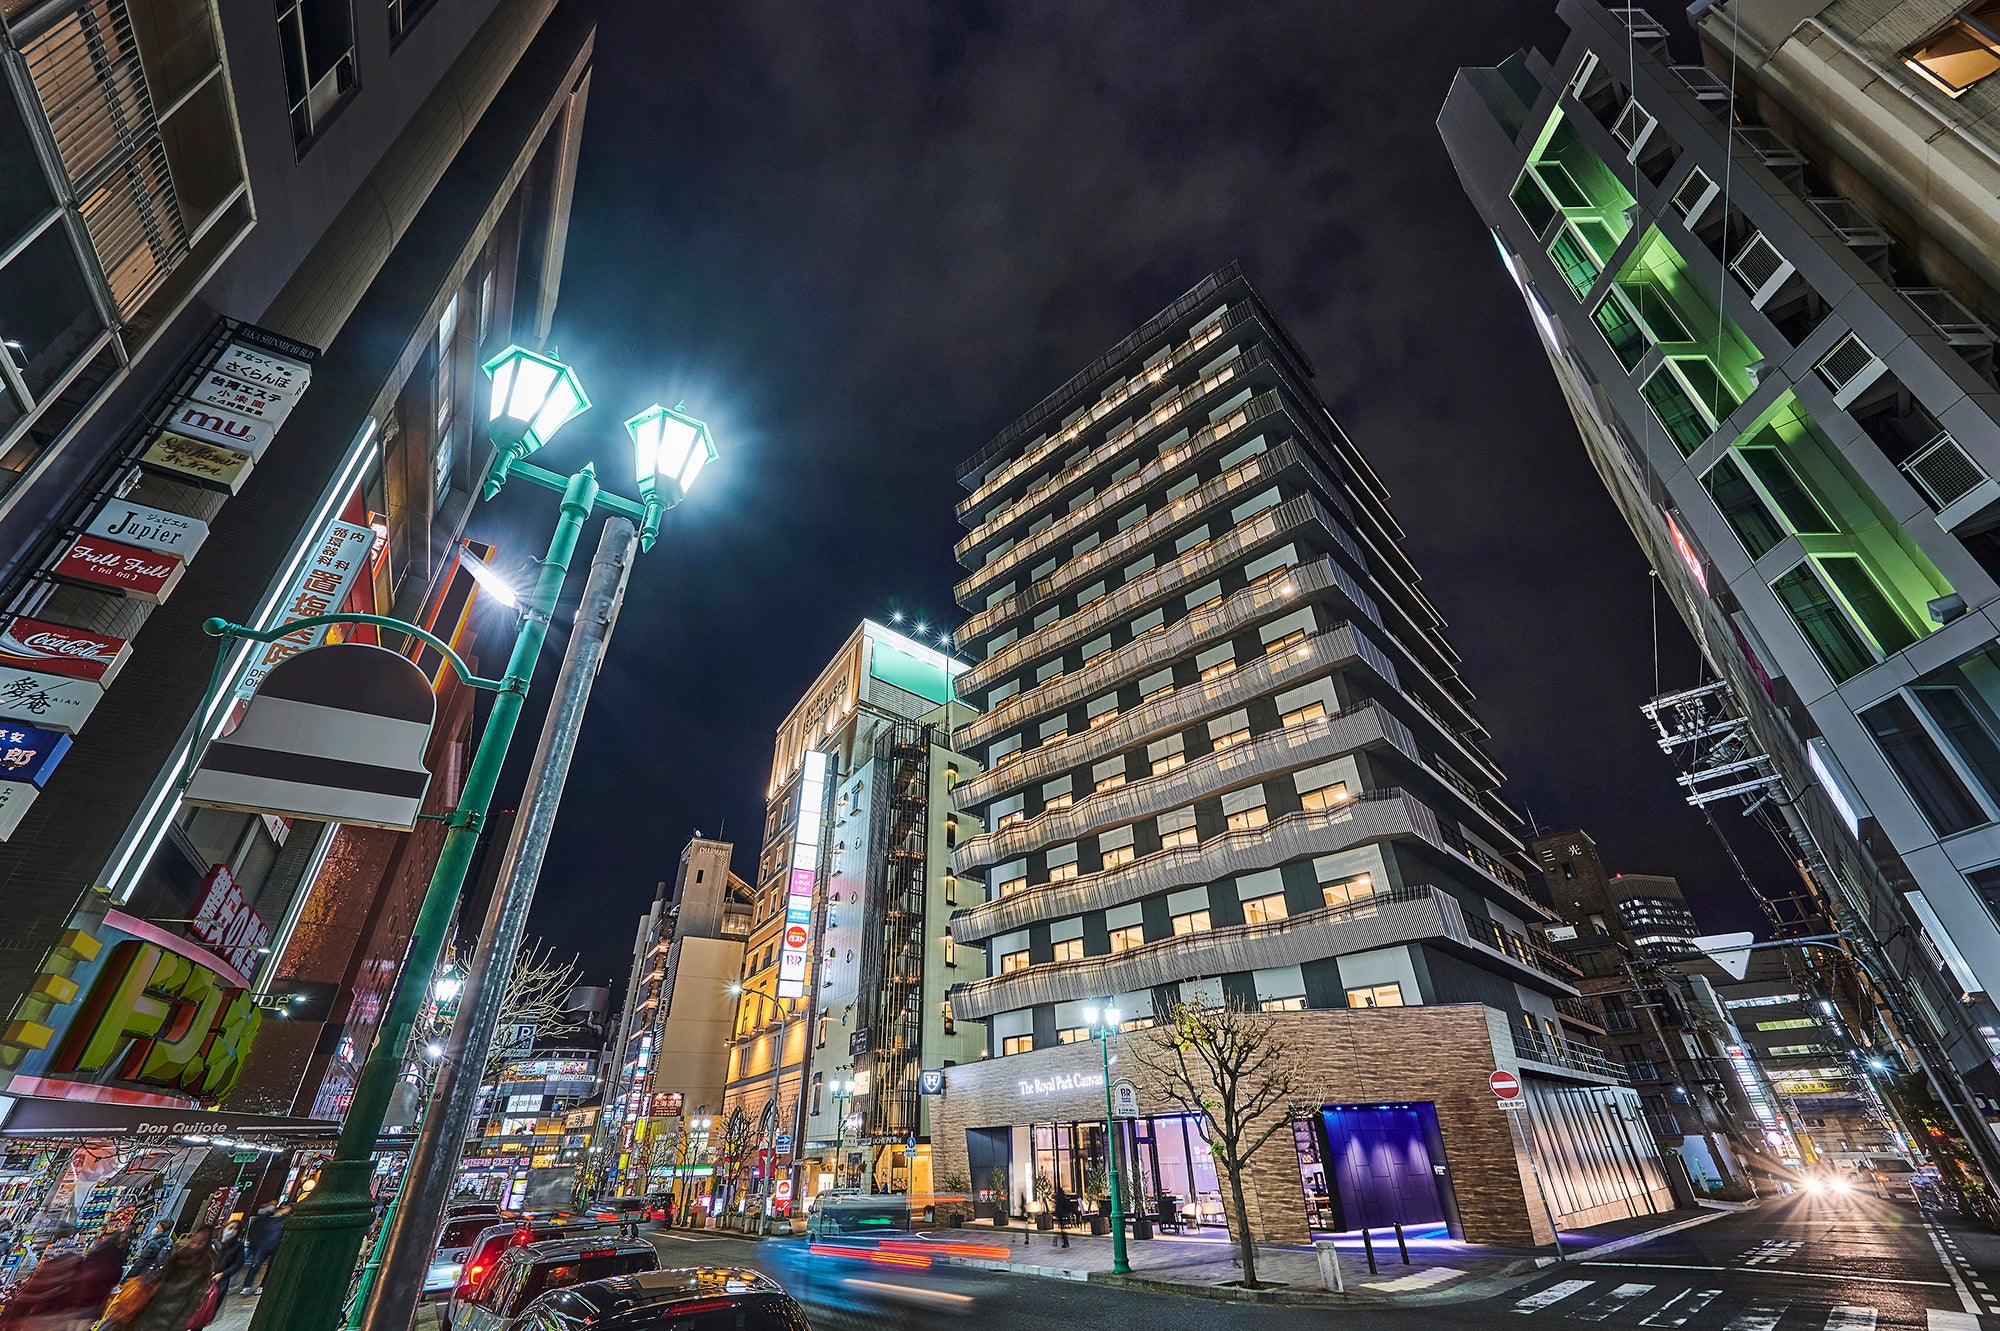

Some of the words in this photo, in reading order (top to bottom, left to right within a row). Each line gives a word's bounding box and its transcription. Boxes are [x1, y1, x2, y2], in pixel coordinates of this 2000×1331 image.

[234, 349, 272, 367] すなっく
[226, 362, 291, 388] さくらんぼ
[210, 376, 282, 402] 台湾エステ
[181, 409, 252, 437] mu
[108, 511, 182, 544] Jupier
[72, 545, 120, 567] Frill
[123, 558, 169, 579] Frill
[52, 698, 80, 706] AIAN
[787, 933, 806, 943] ガスト
[1019, 1080, 1034, 1095] The
[1034, 1077, 1055, 1096] Royal
[1055, 1075, 1074, 1090] Park
[1073, 1073, 1104, 1088] Canvas
[1120, 1088, 1131, 1097] BR
[137, 1122, 168, 1134] Don
[173, 1122, 228, 1135] Quijote
